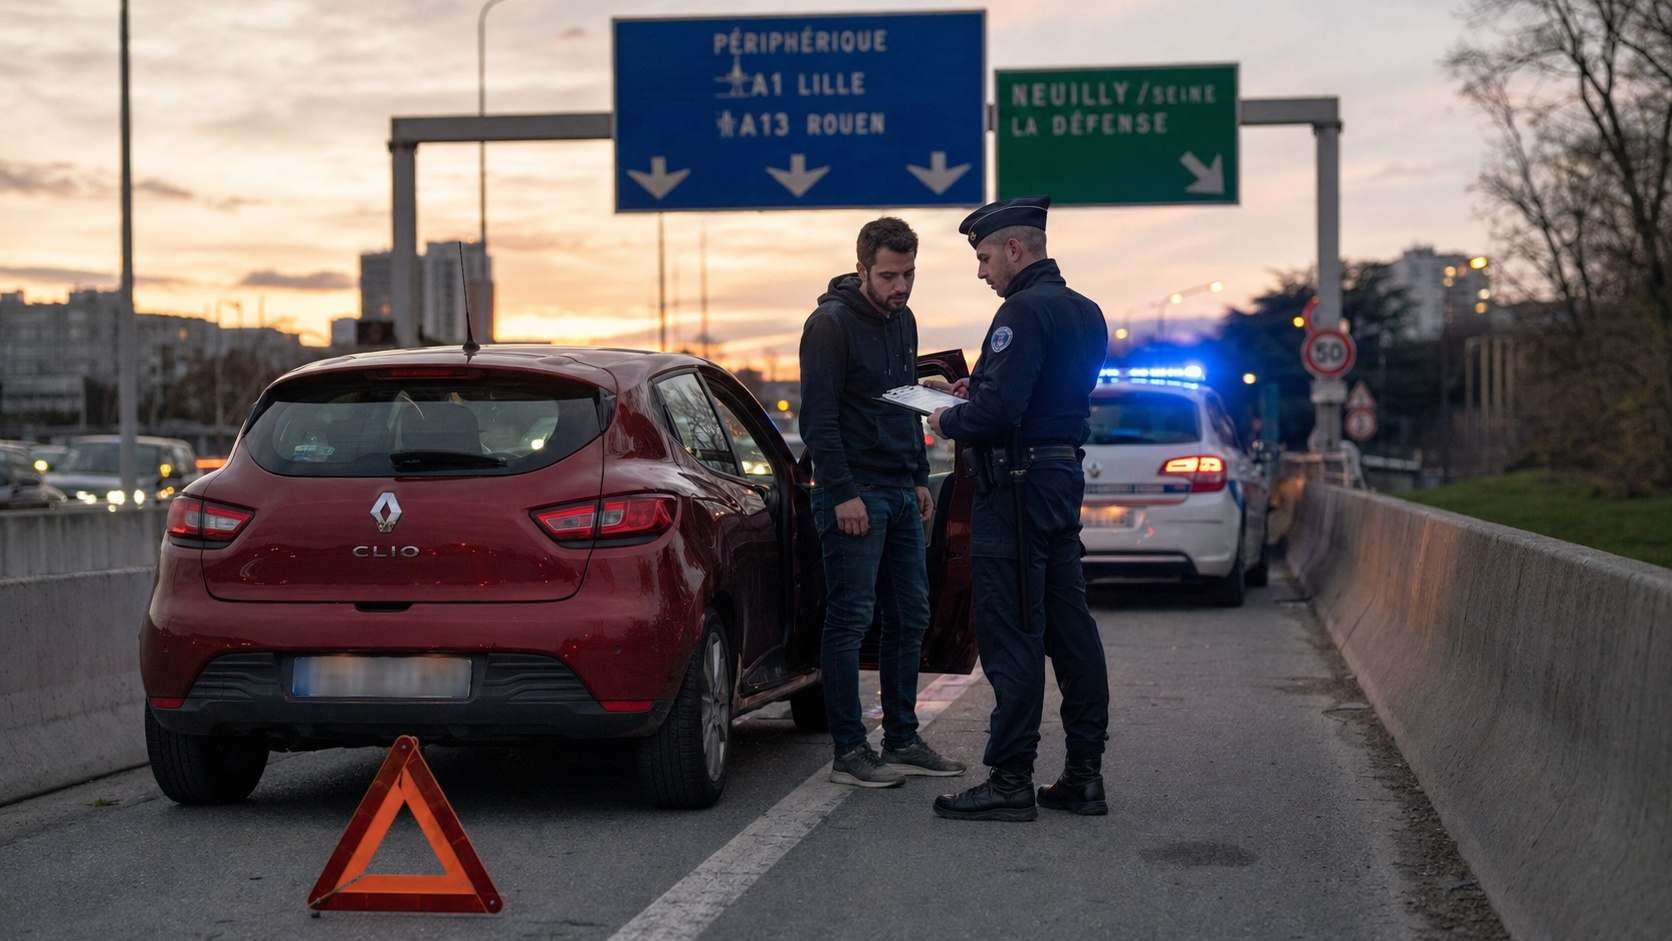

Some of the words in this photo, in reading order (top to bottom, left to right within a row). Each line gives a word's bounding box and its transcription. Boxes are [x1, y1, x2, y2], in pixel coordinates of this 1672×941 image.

[713, 26, 888, 55] PÉRIPHÉRIQUE
[751, 72, 783, 97] A1
[798, 71, 866, 96] LILLE
[1011, 80, 1130, 107] NEUILLY
[739, 112, 790, 137] A13
[806, 111, 886, 136] ROUEN
[1011, 116, 1039, 137] LA
[1051, 109, 1169, 136] DÉFENSE
[1315, 341, 1344, 364] 50
[352, 545, 420, 558] CLIO
